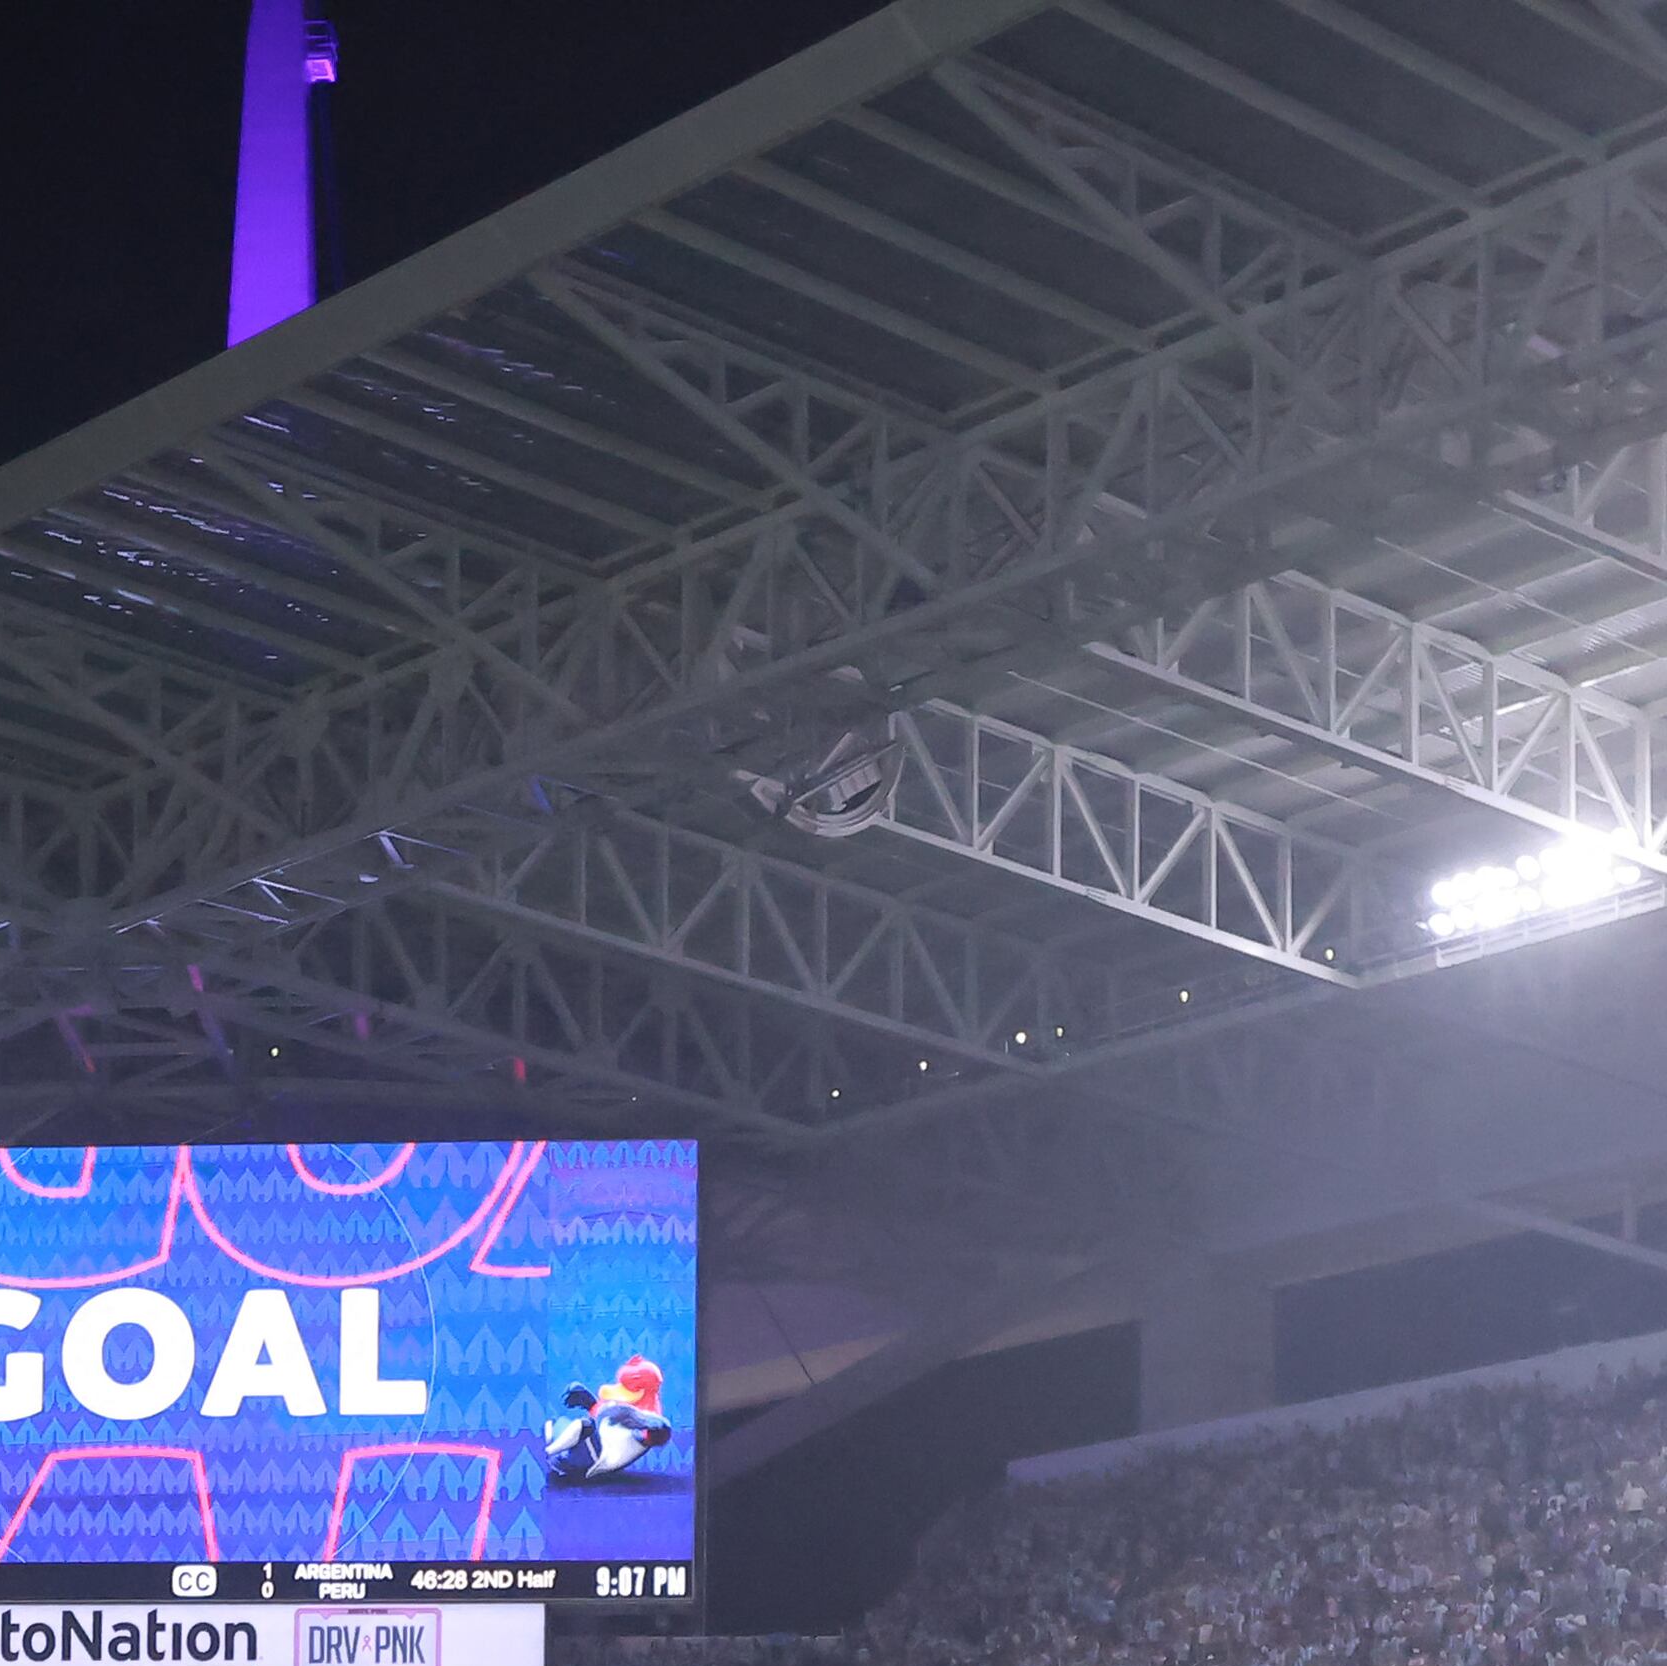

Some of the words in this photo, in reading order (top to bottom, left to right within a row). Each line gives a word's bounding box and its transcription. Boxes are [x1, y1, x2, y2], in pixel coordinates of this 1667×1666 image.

[178, 1571, 212, 1593] CC
[260, 1581, 275, 1598] 0
[318, 1583, 367, 1599] PERU
[261, 1563, 274, 1579] 1
[294, 1563, 394, 1581] ARGENTINA
[410, 1569, 467, 1590] 46:28
[471, 1569, 514, 1589] 2ND
[518, 1568, 557, 1590] Half
[595, 1566, 646, 1597] 9:07
[654, 1567, 687, 1597] PM
[308, 1625, 362, 1665] DRV
[374, 1625, 426, 1664] PNK
